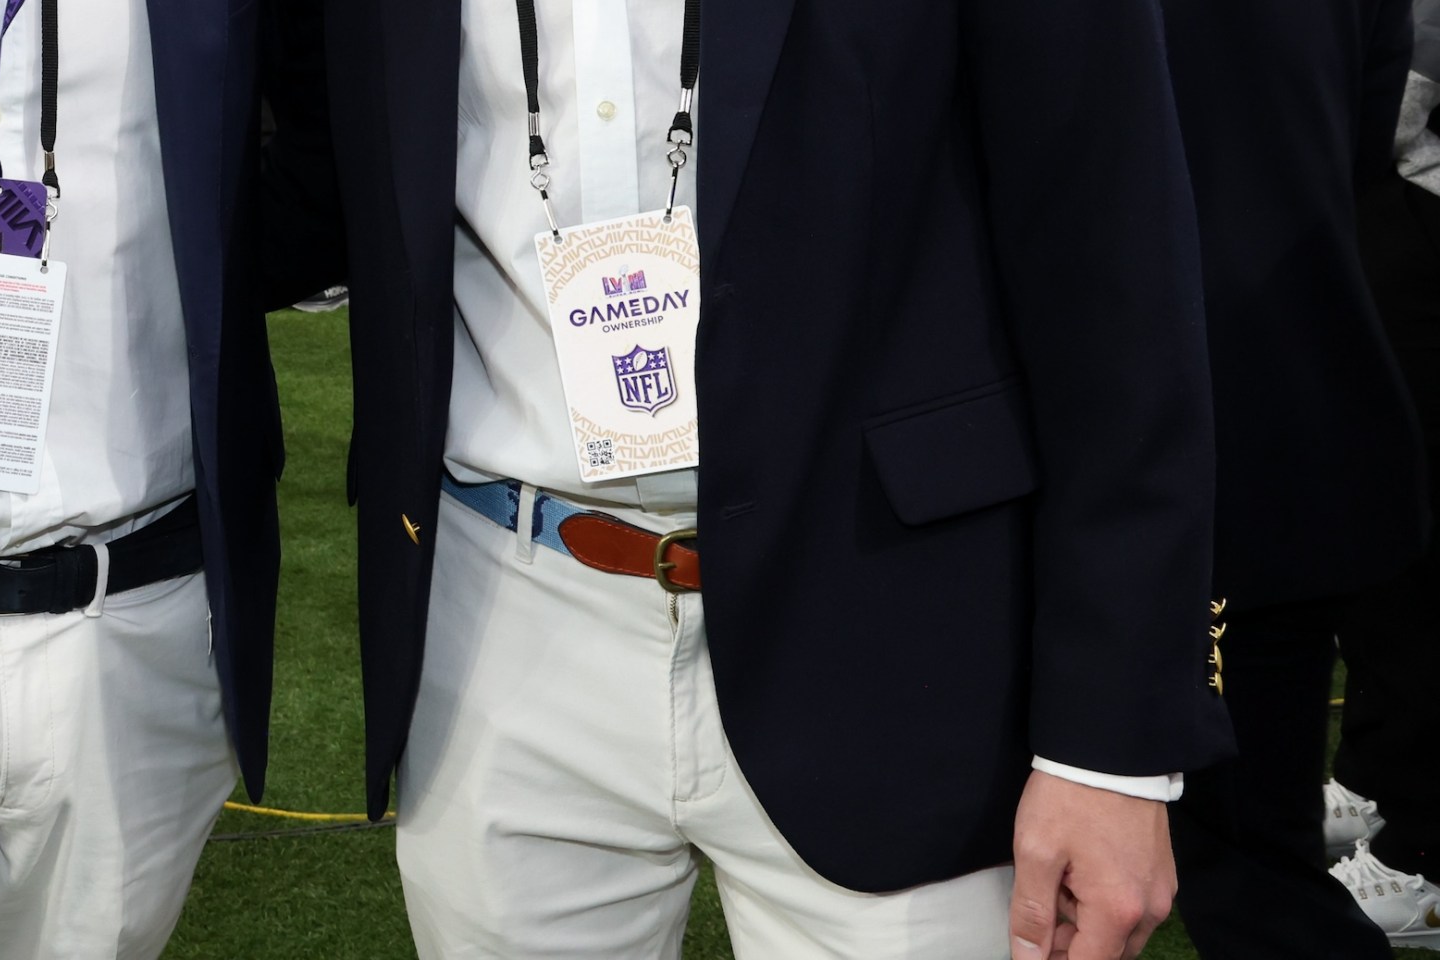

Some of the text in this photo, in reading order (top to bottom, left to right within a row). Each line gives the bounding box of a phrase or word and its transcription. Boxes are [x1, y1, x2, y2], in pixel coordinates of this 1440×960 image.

[569, 289, 689, 327] GAMEDAY
[602, 315, 664, 334] OWNERSHIP
[623, 372, 669, 404] NFL
